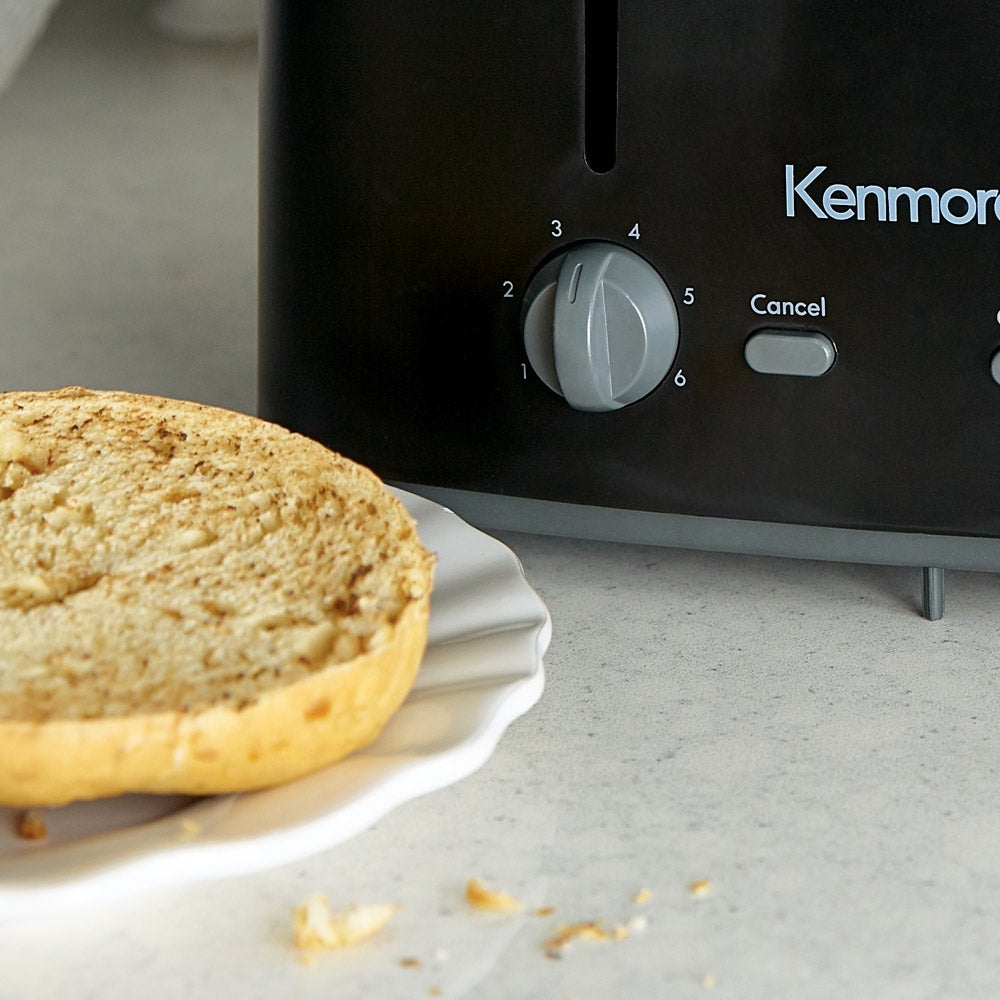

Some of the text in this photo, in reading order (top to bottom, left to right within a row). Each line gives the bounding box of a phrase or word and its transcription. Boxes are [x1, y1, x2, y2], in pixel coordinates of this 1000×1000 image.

[550, 219, 563, 238] 3
[627, 223, 641, 240] 4
[502, 280, 514, 298] 2
[682, 287, 695, 305] 5
[750, 293, 826, 317] Cancel
[520, 363, 528, 380] 1
[674, 368, 687, 388] 6
